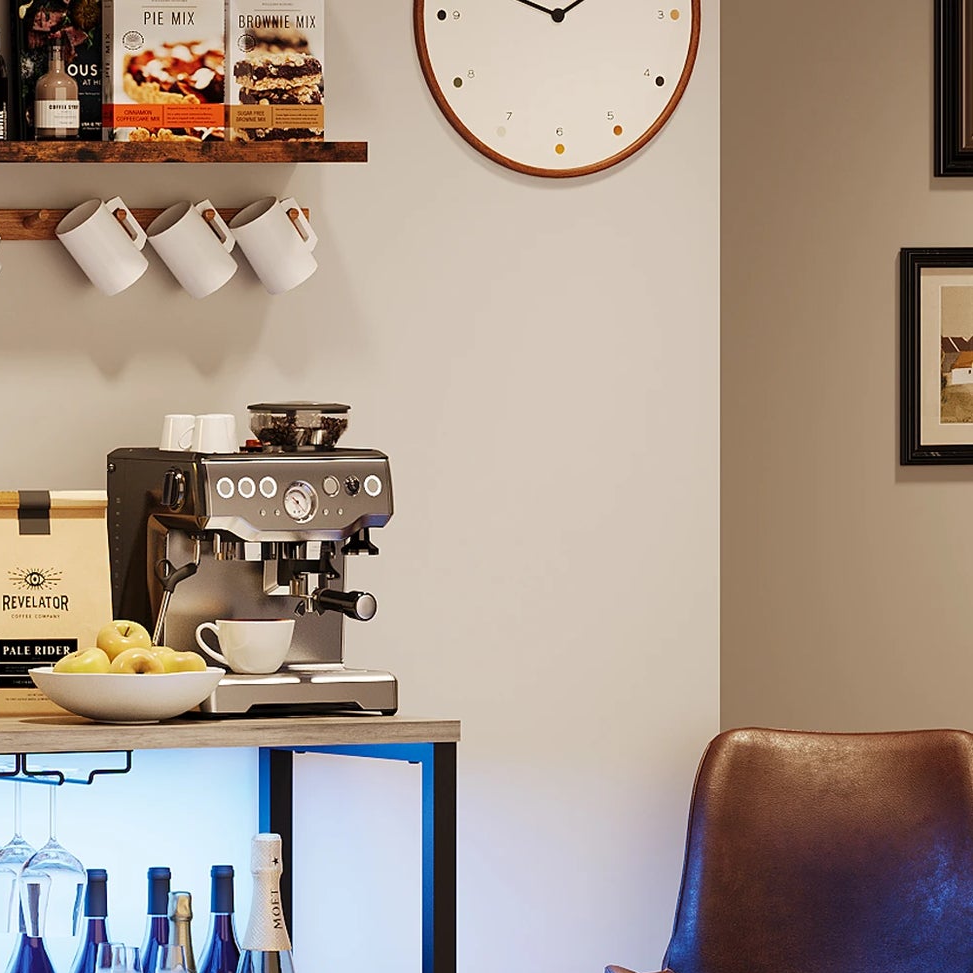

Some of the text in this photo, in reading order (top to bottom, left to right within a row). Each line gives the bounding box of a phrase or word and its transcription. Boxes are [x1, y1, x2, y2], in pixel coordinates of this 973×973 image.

[143, 11, 195, 25] PIE MIX
[452, 10, 461, 20] 9
[657, 10, 665, 20] 3
[238, 14, 316, 29] BROWNIE MIX
[467, 69, 475, 79] 8
[643, 68, 651, 78] 4
[505, 112, 513, 121] 7
[607, 111, 614, 121] 5
[555, 127, 563, 137] 6
[2, 594, 69, 612] REVELATOR
[3, 645, 71, 656] PALE RIDER
